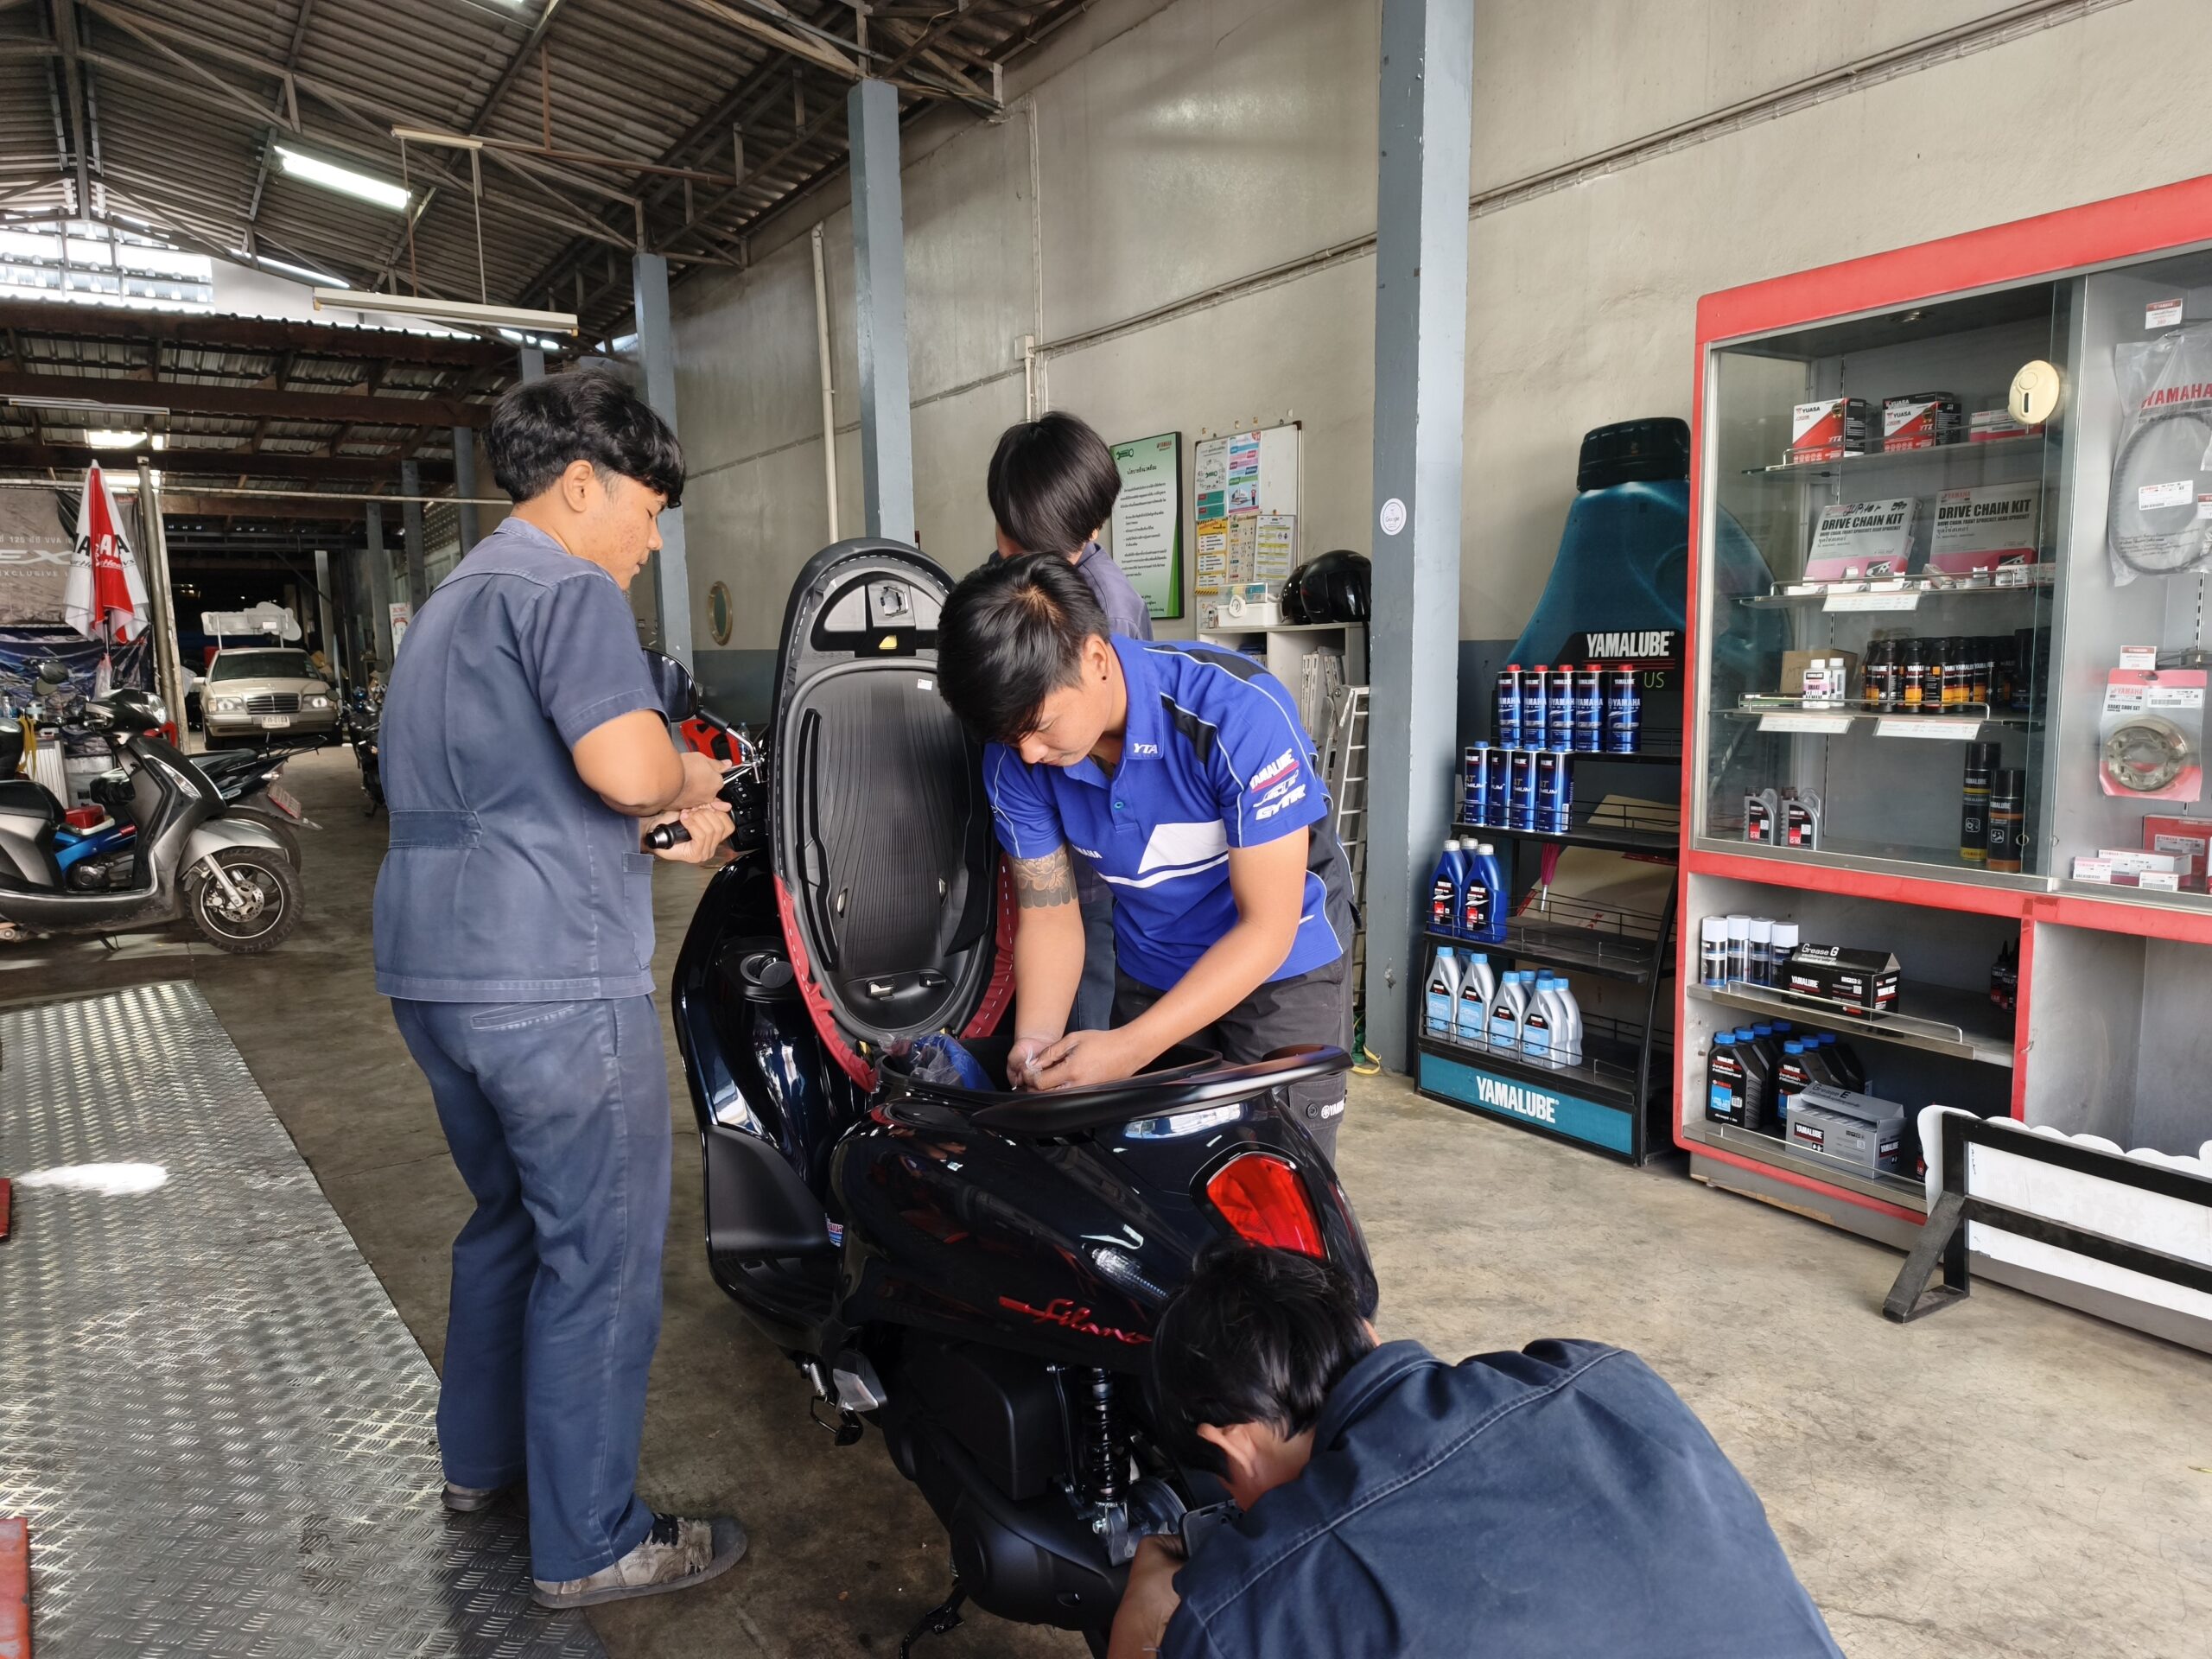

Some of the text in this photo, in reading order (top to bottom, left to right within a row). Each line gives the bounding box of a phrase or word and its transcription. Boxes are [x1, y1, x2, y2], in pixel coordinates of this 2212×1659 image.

[1939, 499, 2031, 519] DRIVE CHAIN KIT
[1821, 513, 1904, 531] DRIVE CHAIN KIT
[1586, 631, 1669, 658] YAMALUBE
[1643, 671, 1665, 689] US
[1612, 697, 1641, 707] YAMAHA
[1134, 742, 1158, 754] YTA
[1801, 943, 1840, 957] Grease G
[1791, 975, 1820, 988] YAMALUBE
[1812, 1082, 1840, 1097] Grease
[1840, 1090, 1851, 1099] E
[1476, 1075, 1555, 1124] YAMALUBE
[1796, 1123, 1824, 1140] YAMALUBE
[1880, 1141, 1899, 1154] YAMALUBE
